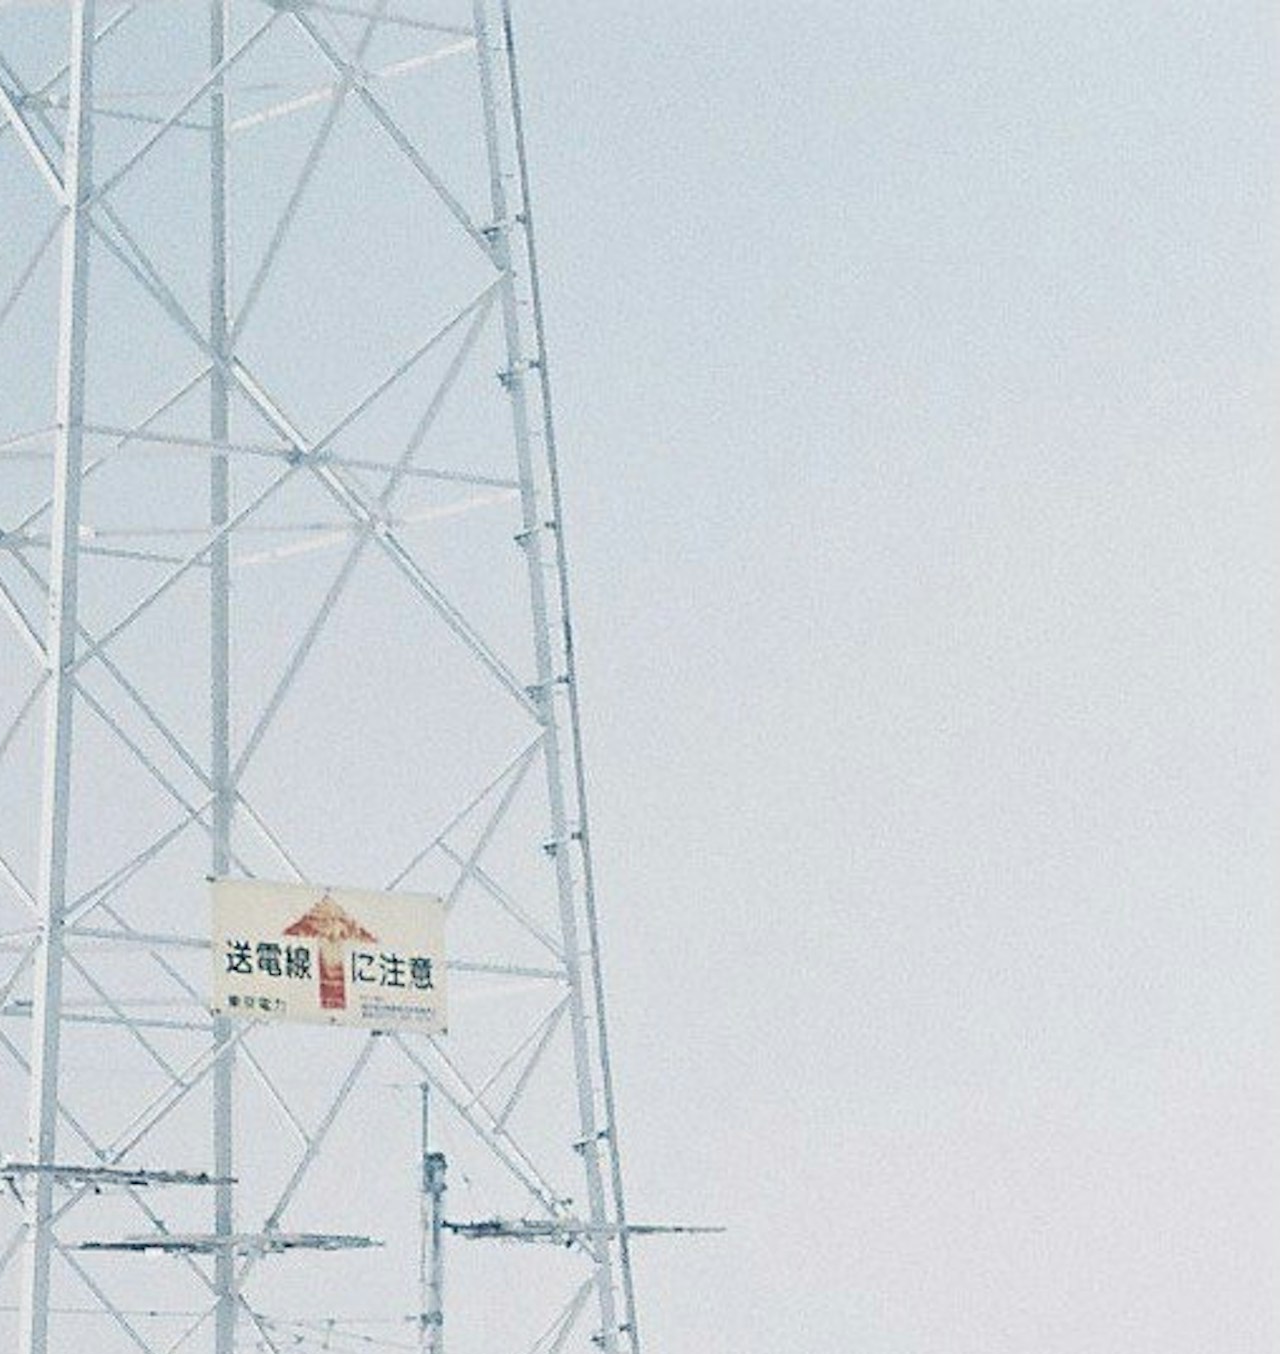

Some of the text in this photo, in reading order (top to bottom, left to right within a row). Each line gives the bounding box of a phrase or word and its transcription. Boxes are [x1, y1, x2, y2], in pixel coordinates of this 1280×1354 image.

[226, 940, 434, 989] 送電線 に注意
